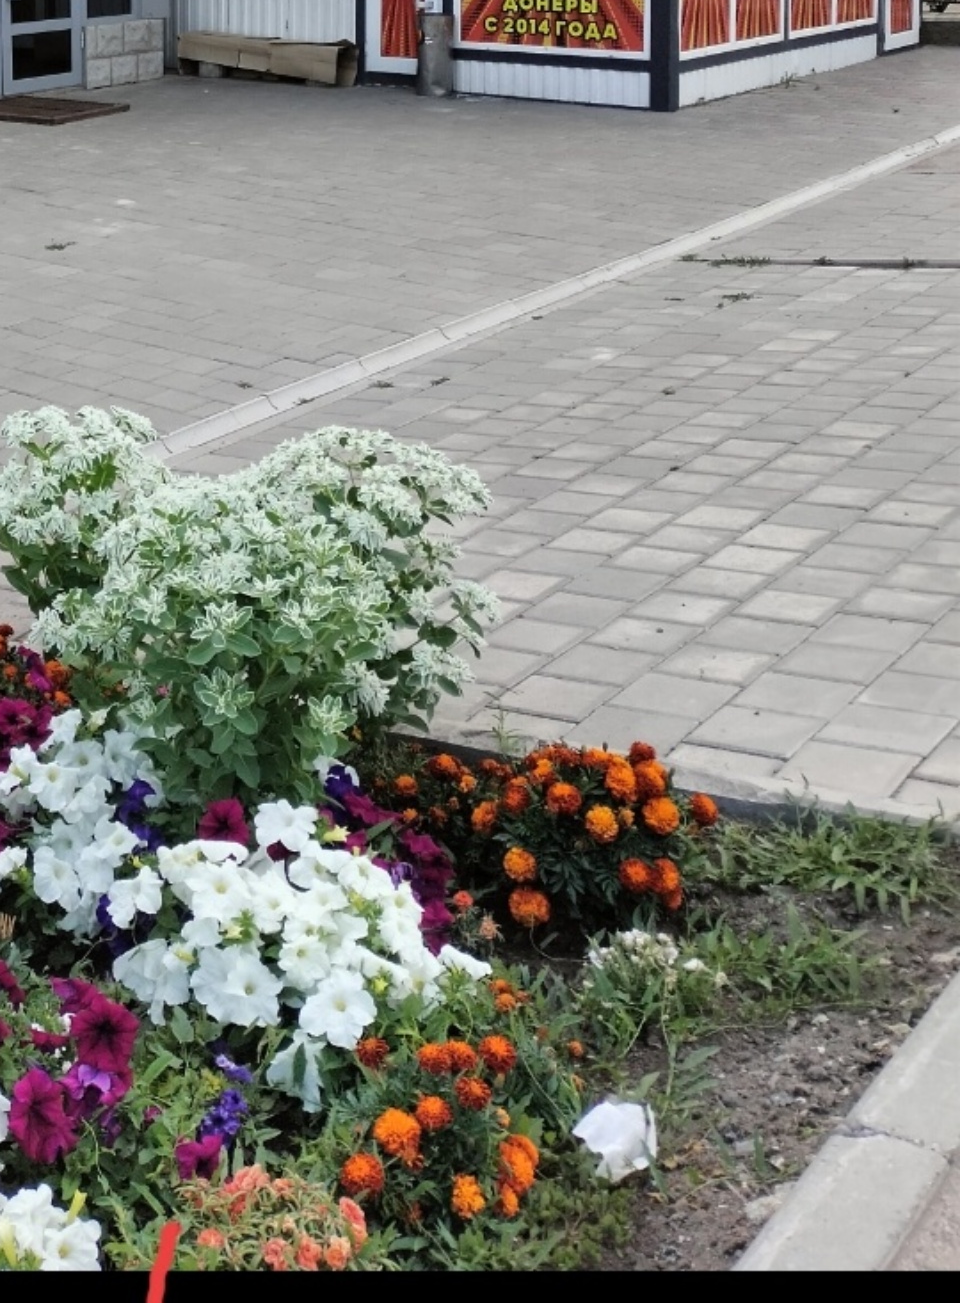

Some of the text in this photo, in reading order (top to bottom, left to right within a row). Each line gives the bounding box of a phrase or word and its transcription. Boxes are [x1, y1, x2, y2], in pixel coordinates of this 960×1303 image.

[484, 17, 618, 40] С 2014 ГОДА
